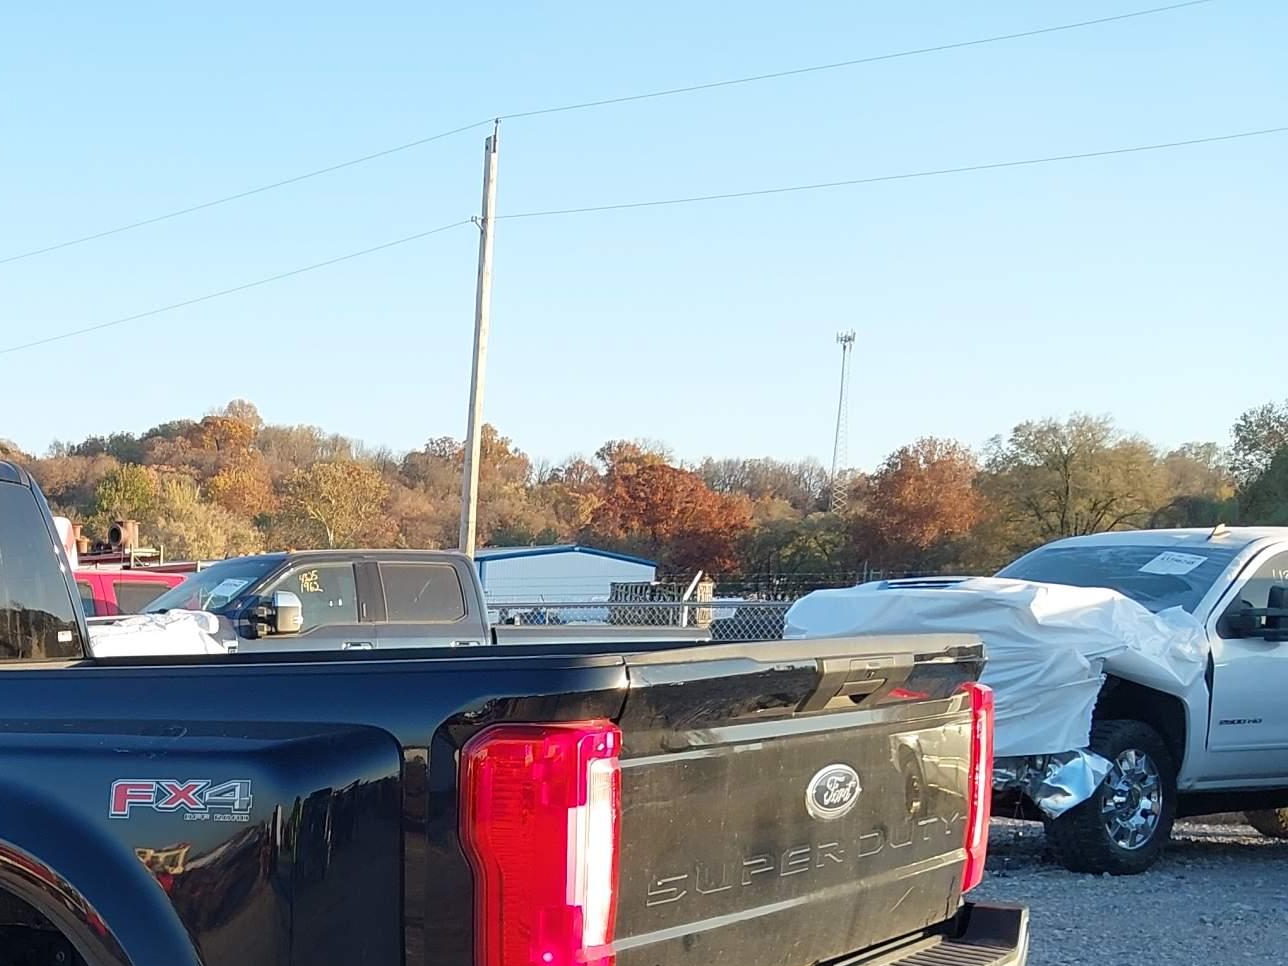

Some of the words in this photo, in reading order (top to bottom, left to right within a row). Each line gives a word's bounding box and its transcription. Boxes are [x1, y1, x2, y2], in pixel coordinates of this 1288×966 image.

[109, 778, 253, 819] FX4
[646, 842, 846, 907] SUPER
[857, 812, 963, 858] DUTY
